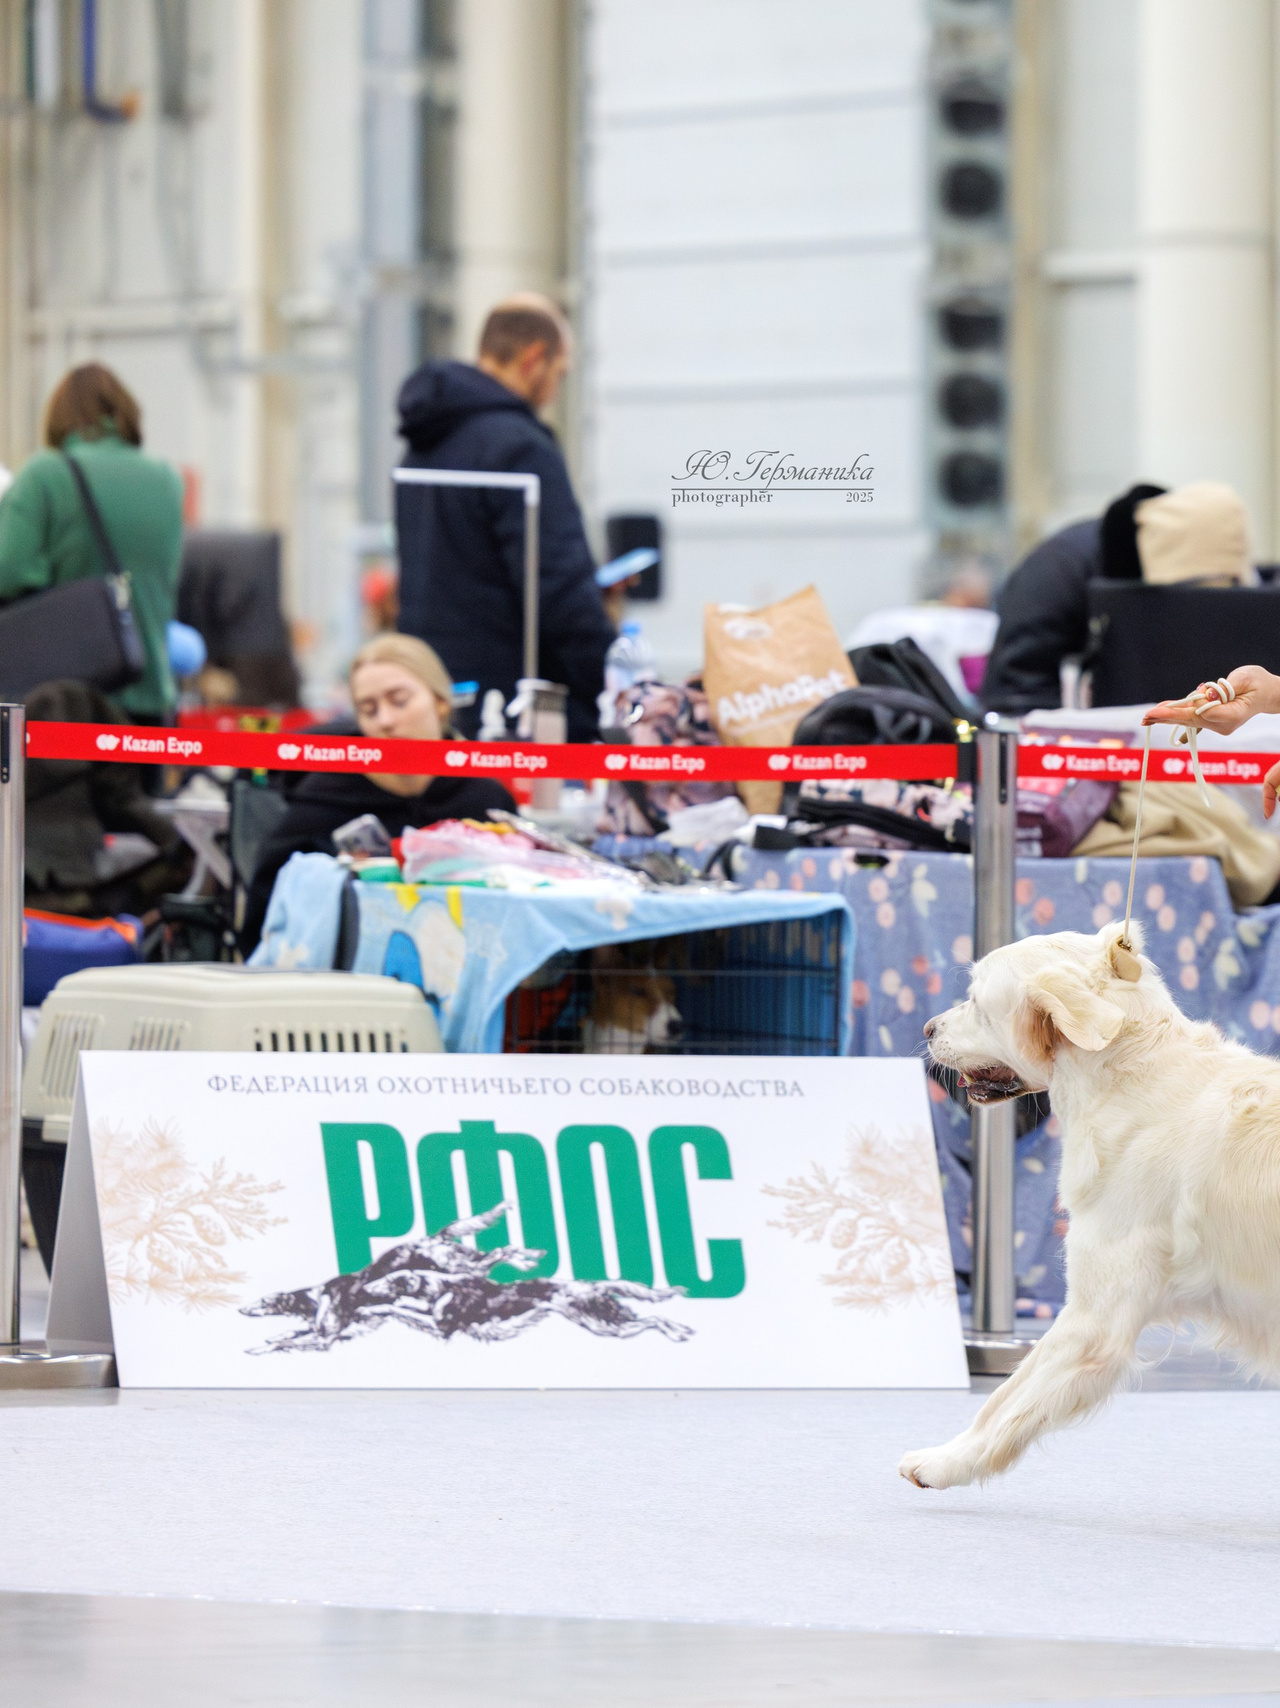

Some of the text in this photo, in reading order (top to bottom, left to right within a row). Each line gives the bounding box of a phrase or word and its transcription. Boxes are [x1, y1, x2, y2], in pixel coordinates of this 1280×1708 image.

[122, 735, 203, 758] Kazan Expo
[303, 745, 382, 765] Kazan Expo
[470, 751, 548, 771] Kazan Expo
[629, 754, 706, 774] Kazan Expo
[792, 753, 867, 772] Kazan Expo
[1066, 755, 1140, 775] Kazan Expo
[1227, 759, 1260, 780] Expo
[207, 1075, 805, 1099] ФЕДЕРАЦИЯ ОХОТНИЧЬЕГО СОБАКОВОДСТВА
